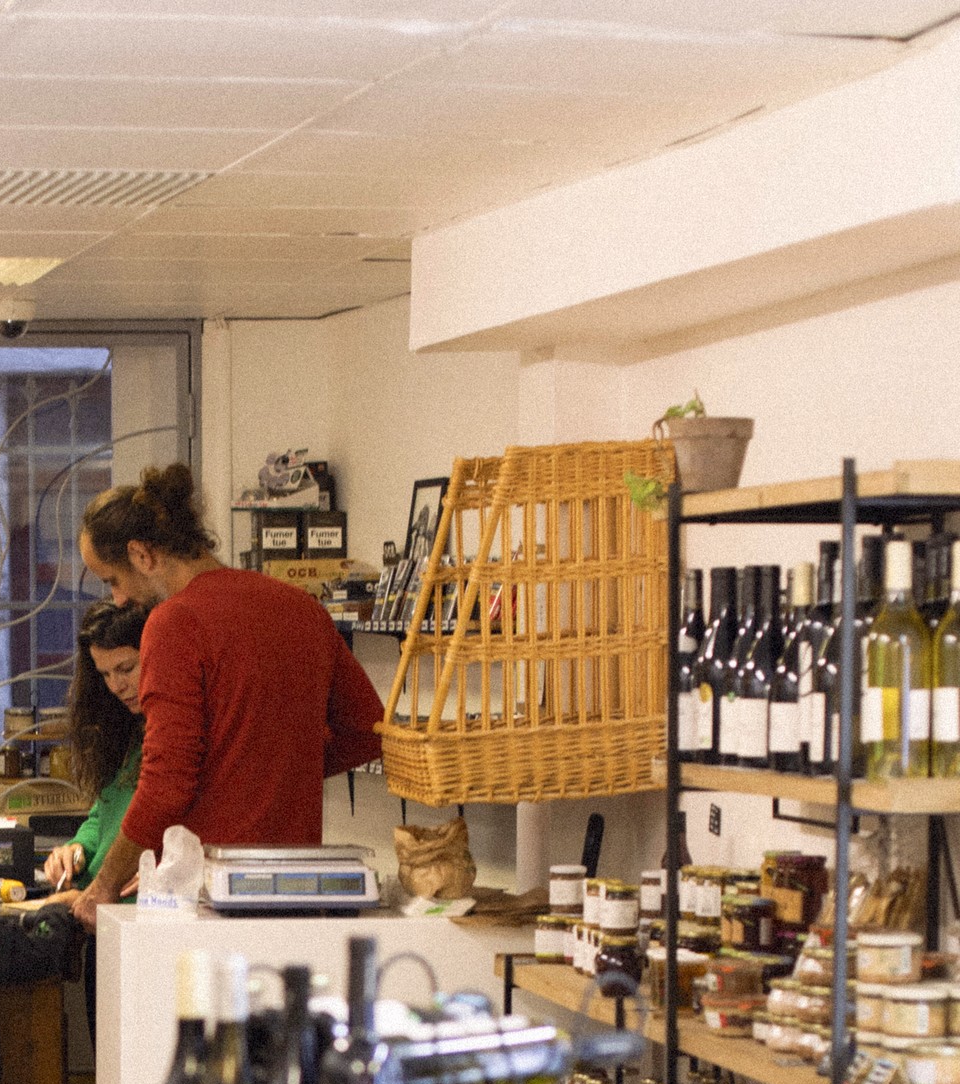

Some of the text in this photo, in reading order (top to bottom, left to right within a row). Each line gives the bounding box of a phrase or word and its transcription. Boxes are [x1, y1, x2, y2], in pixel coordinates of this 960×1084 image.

[265, 530, 293, 538] Fumer
[310, 530, 339, 538] Fumer
[317, 538, 332, 546] tue
[287, 567, 318, 578] OCB
